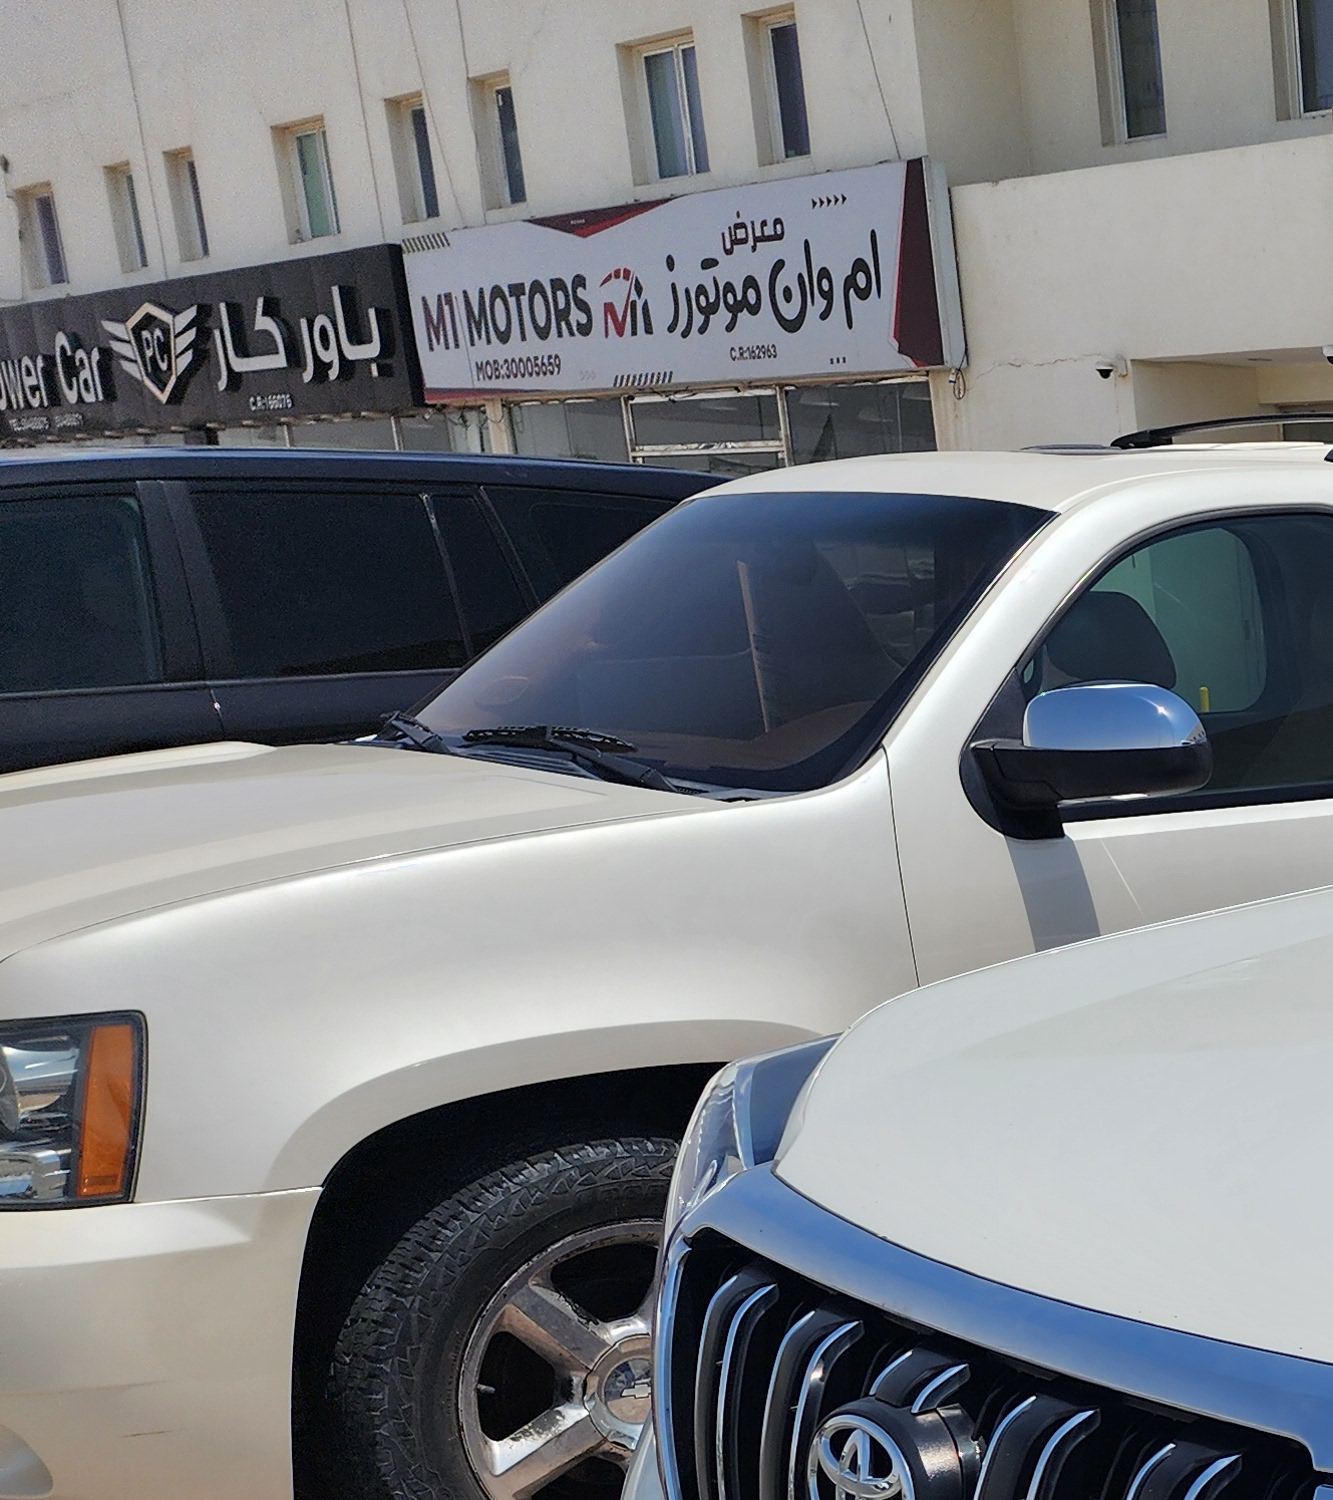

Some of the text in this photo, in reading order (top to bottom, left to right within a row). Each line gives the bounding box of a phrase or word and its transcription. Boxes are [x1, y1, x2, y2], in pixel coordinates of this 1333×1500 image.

[721, 210, 785, 256] معرض
[463, 273, 594, 347] MOTORS
[665, 228, 881, 339] ام وان موتورز
[55, 331, 104, 404] Car
[141, 327, 170, 374] PC
[213, 285, 382, 392] باور كار
[475, 353, 562, 382] MOB:30005659
